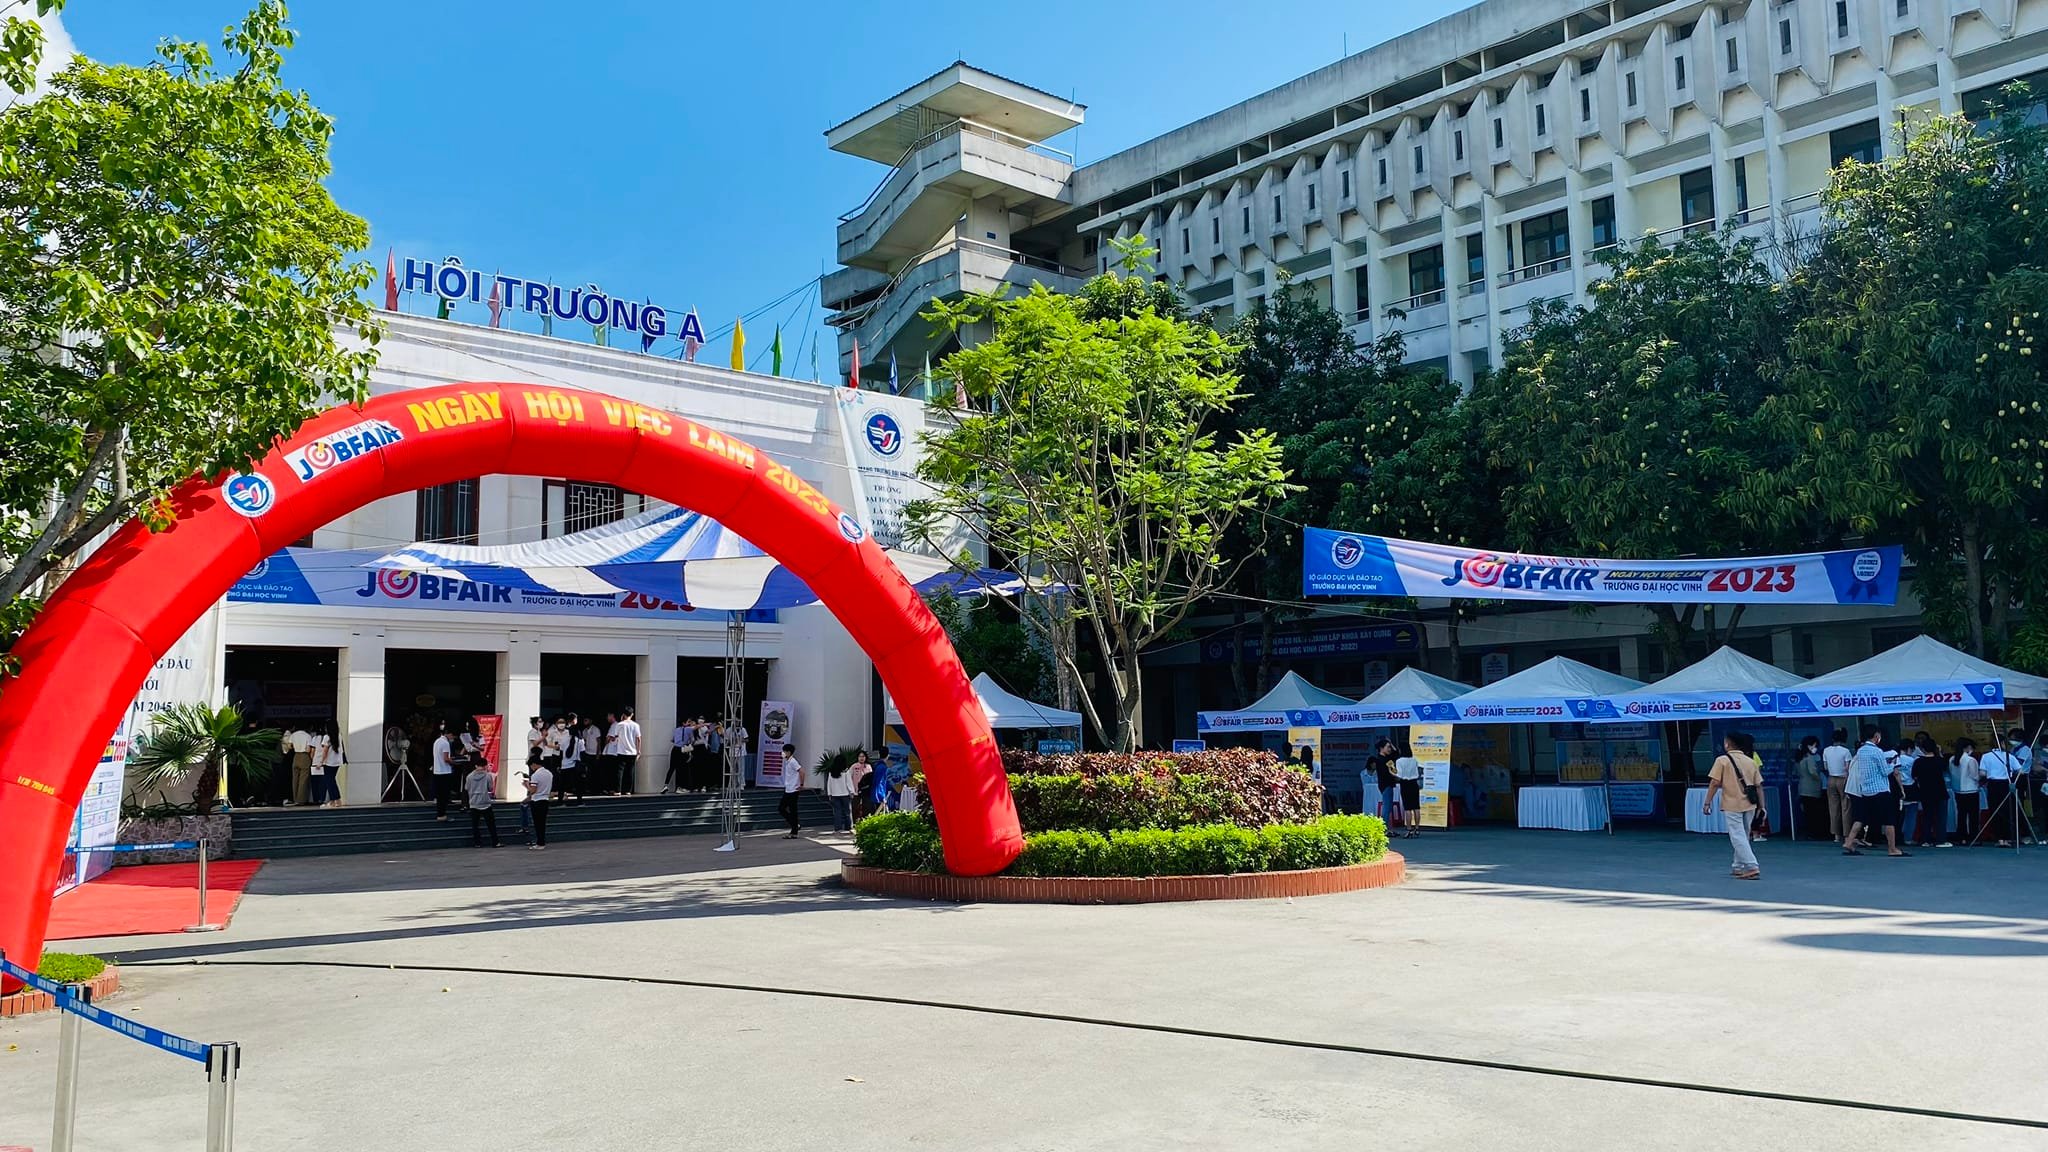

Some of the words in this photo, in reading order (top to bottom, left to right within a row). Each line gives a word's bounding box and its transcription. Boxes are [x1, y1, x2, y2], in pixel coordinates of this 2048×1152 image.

[402, 256, 482, 309] HỘI
[496, 274, 667, 338] TRƯỜNG
[677, 312, 706, 344] A
[301, 426, 402, 481] JOBFAIR
[405, 390, 504, 433] NGÀY
[522, 391, 586, 427] HỘI
[600, 398, 674, 437] VIỆC
[765, 459, 831, 516] 2023
[1441, 552, 1600, 591] JOBFAIR
[1707, 565, 1796, 592] 2023
[1603, 581, 1640, 591] TRƯỜNG
[1642, 582, 1657, 594] ĐẠI
[1660, 582, 1679, 594] HỌC
[522, 595, 558, 606] TRƯỜNG
[560, 597, 575, 609] ĐẠI
[576, 598, 595, 609] HỌC
[597, 600, 616, 609] VINH
[167, 656, 193, 669] ĐẦU
[1822, 694, 1879, 708] JOBFAIR
[1924, 692, 1963, 704] 2023
[148, 701, 172, 712] 2045
[1463, 705, 1504, 717] JOBFAIR
[1536, 706, 1563, 716] 2023
[1624, 701, 1671, 714] JOBFAIR
[1709, 701, 1742, 711] 2023
[1212, 716, 1242, 726] JOBFAIR
[1264, 717, 1285, 725] 2023
[1327, 711, 1360, 722] JOBFAIR
[1386, 711, 1410, 720] 2023
